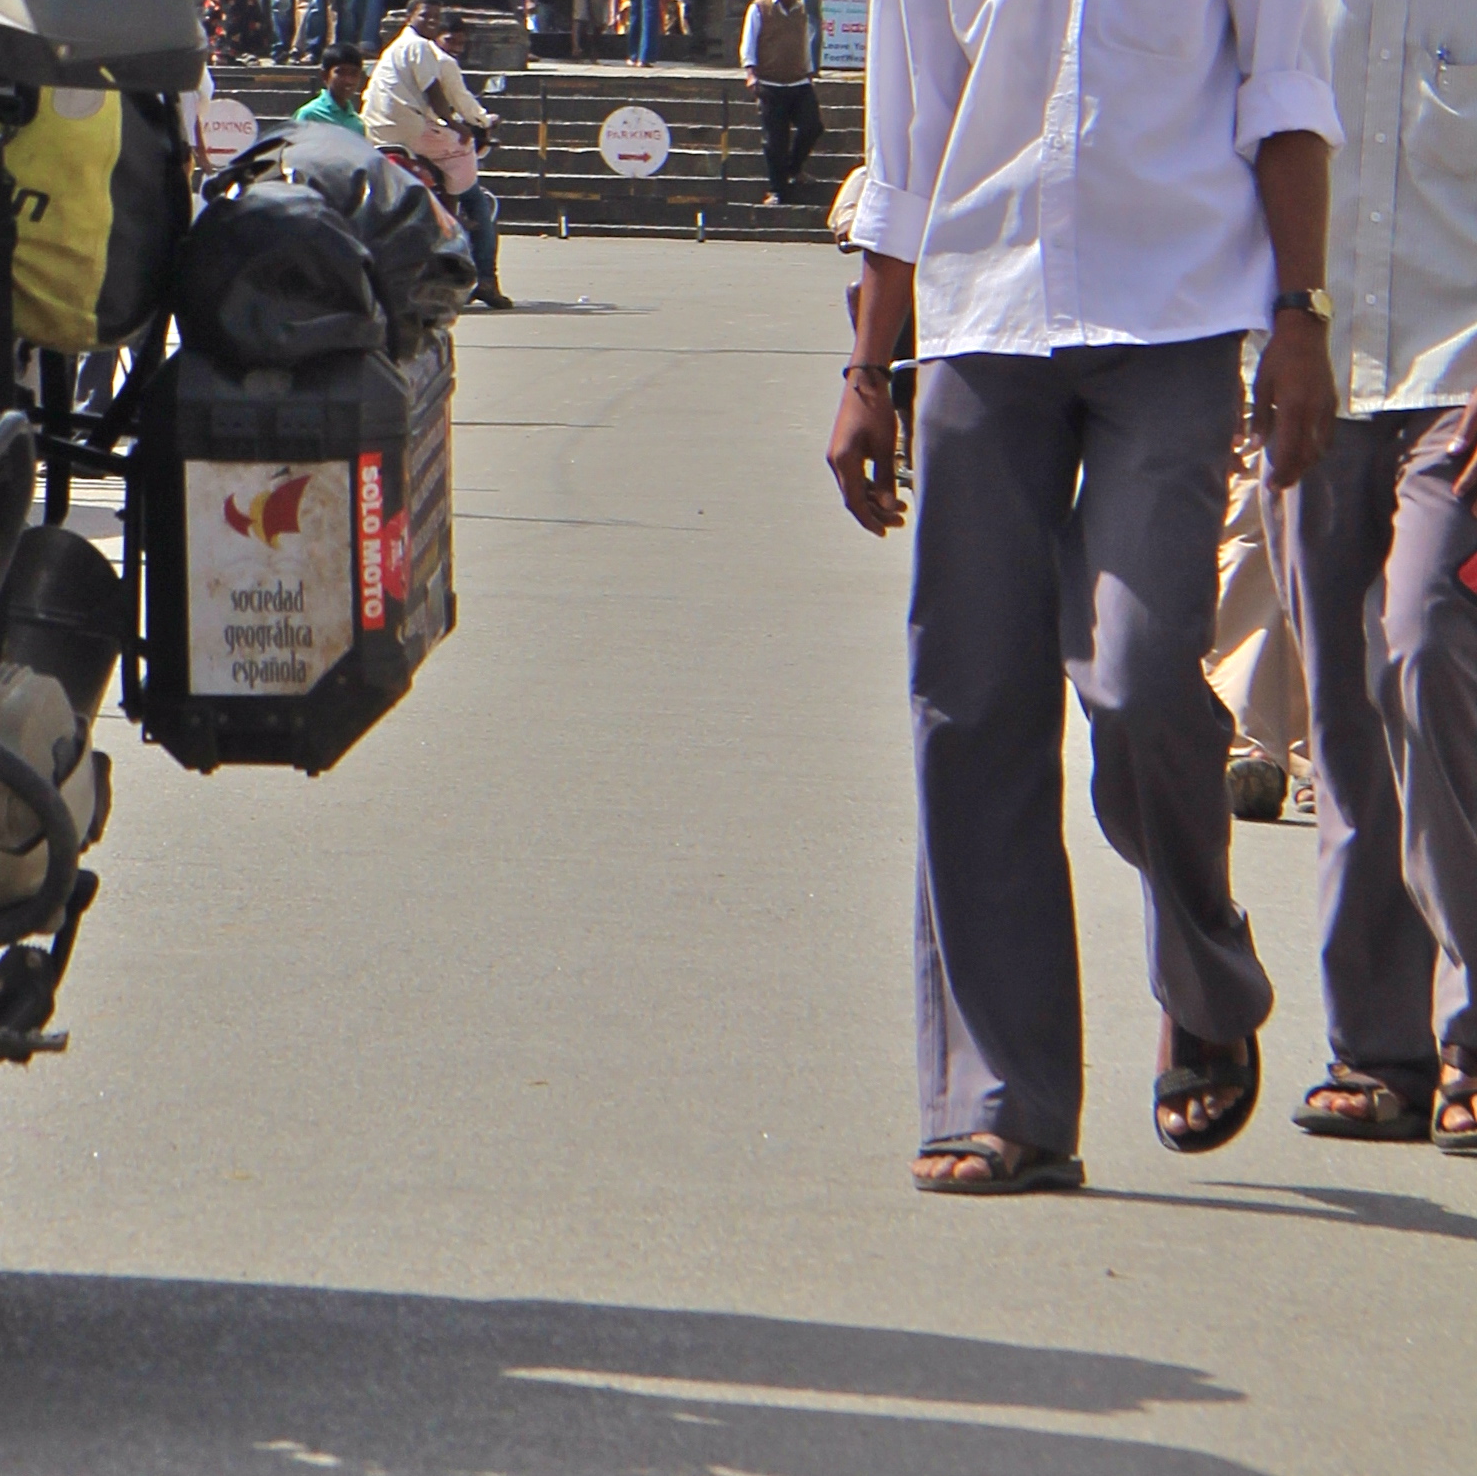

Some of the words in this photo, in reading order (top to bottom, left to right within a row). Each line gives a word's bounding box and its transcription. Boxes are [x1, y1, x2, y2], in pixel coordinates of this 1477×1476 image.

[605, 127, 662, 141] PARKING
[361, 465, 381, 534] SOLO
[230, 579, 305, 614] sociedad
[362, 538, 383, 619] MOTO
[224, 616, 313, 656] geográfica
[231, 650, 308, 689] española
